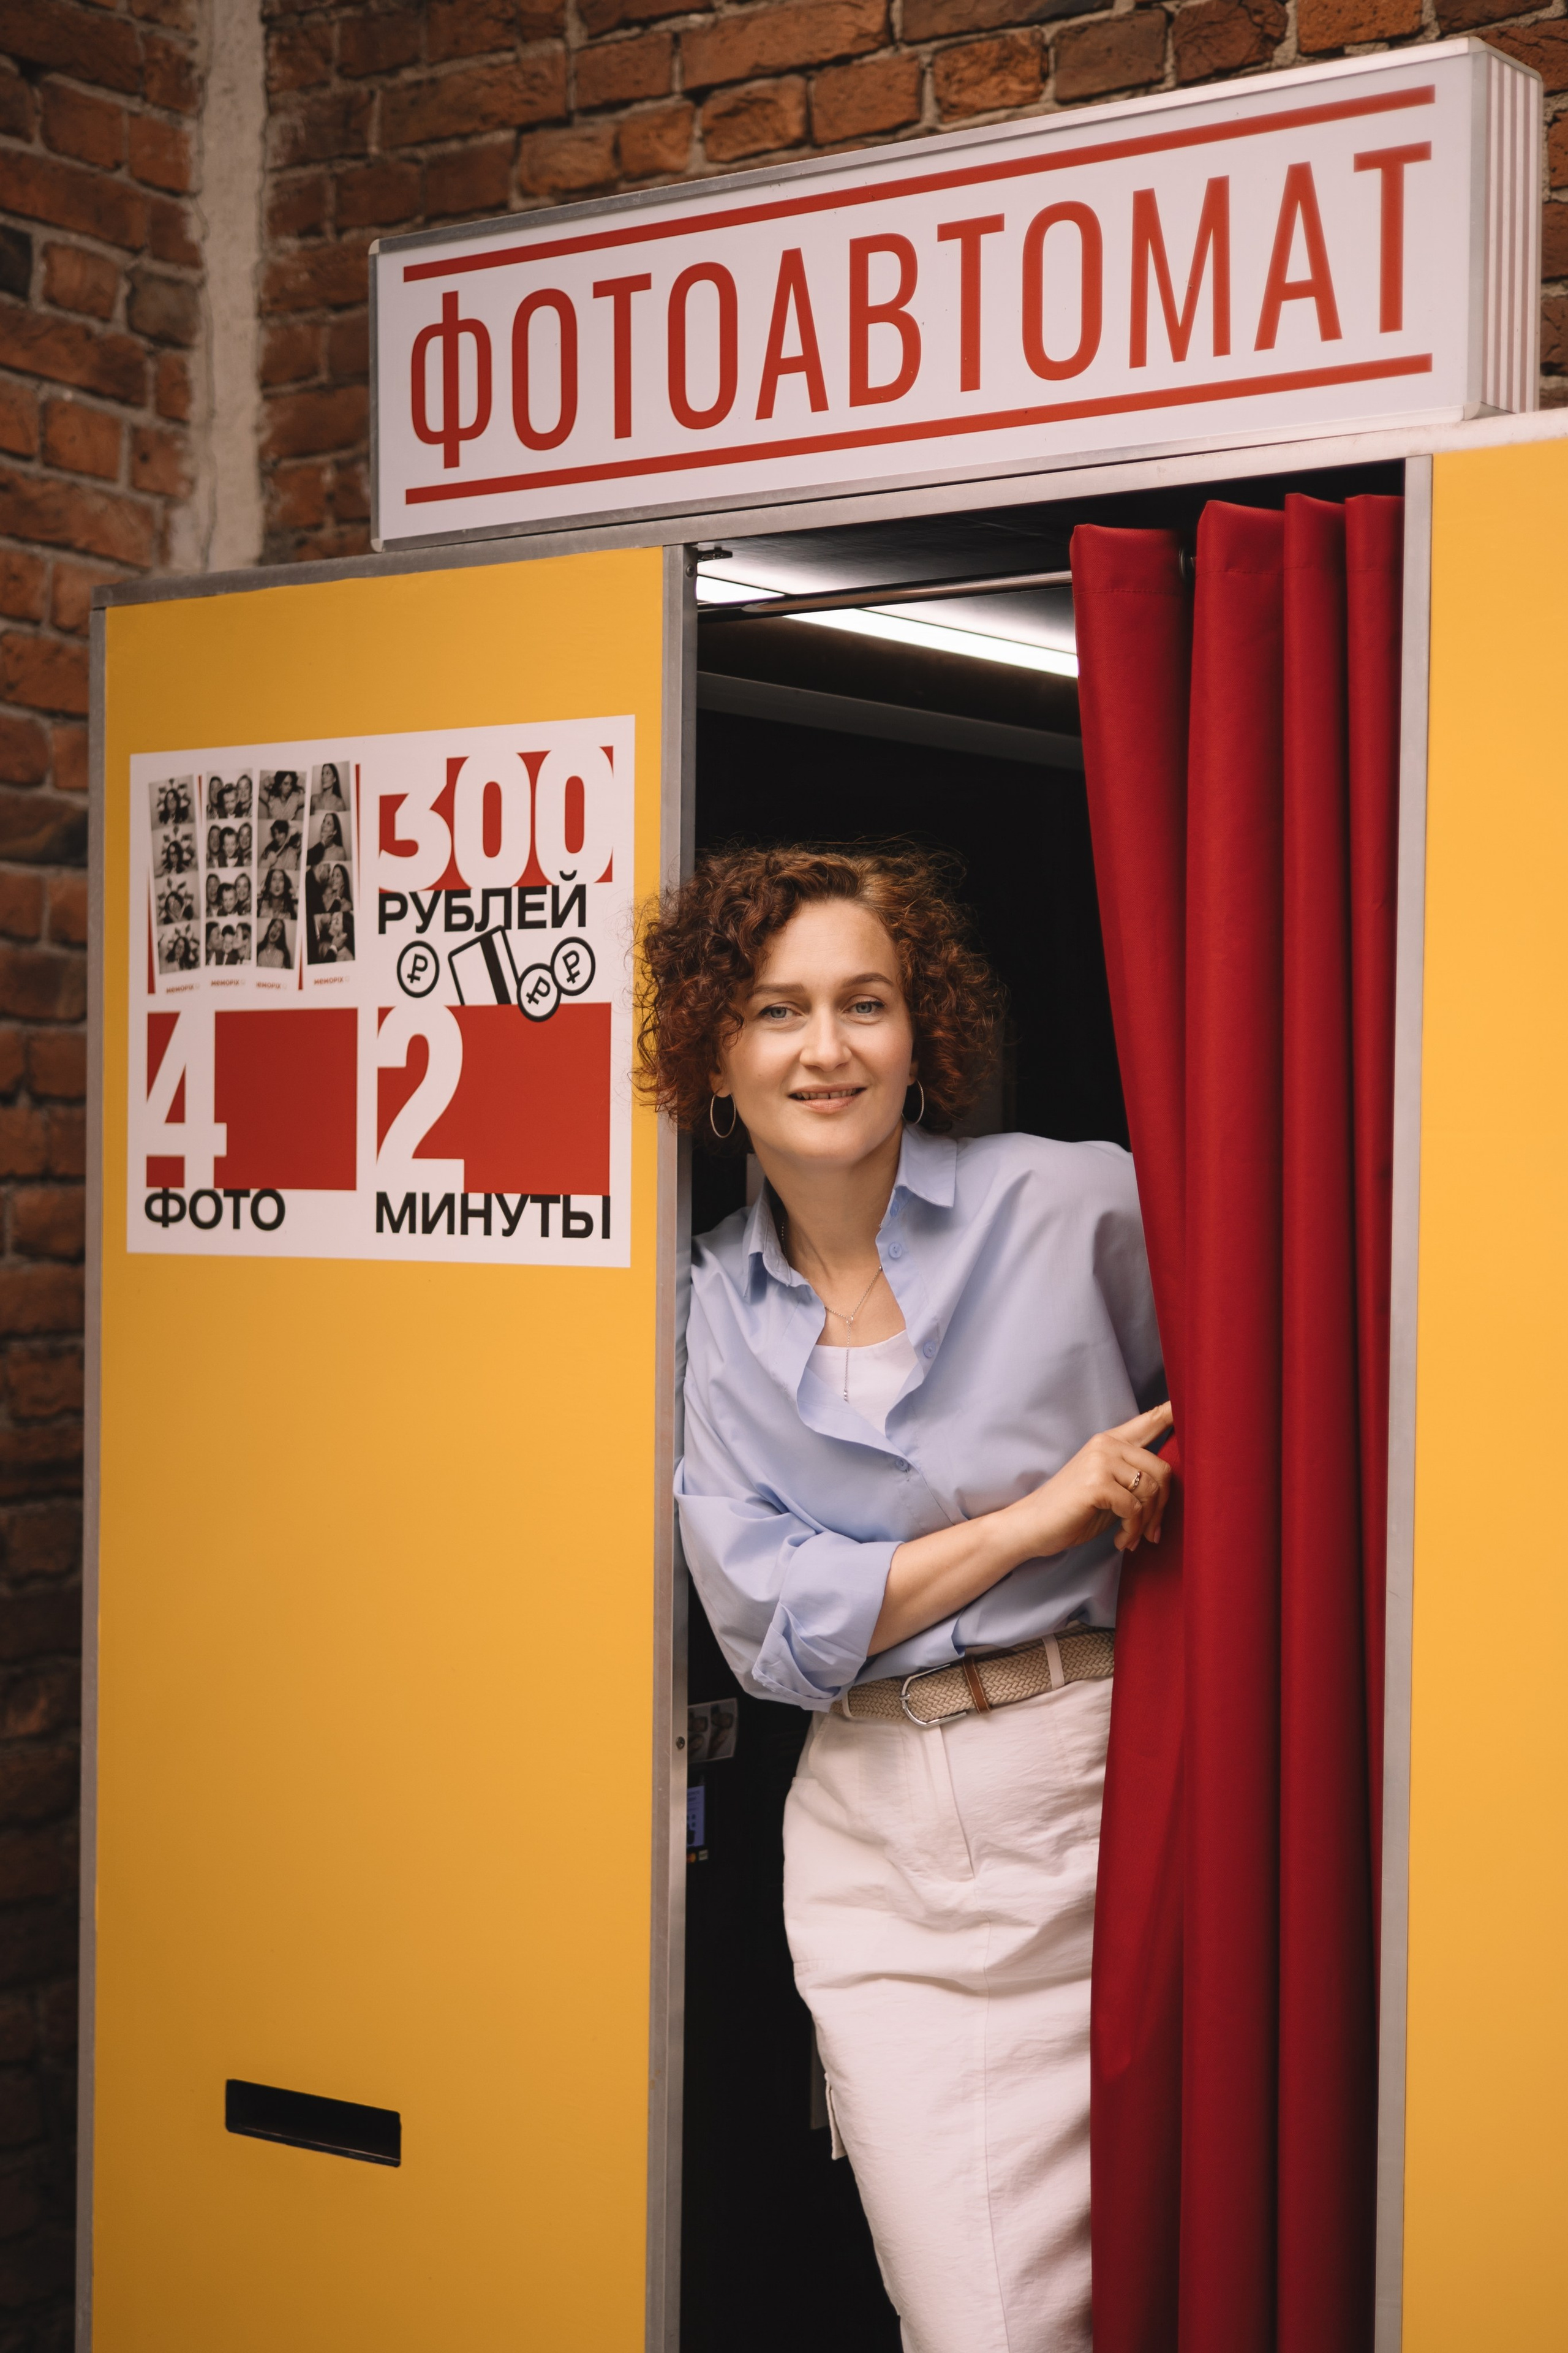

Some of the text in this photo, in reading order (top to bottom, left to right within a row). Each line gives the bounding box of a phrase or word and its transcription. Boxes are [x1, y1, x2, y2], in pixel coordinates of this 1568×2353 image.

[410, 141, 1431, 469] ФОТОАВТОМАТ
[378, 746, 614, 893] 300
[378, 870, 587, 935] РУБЛЕЙ
[147, 1011, 227, 1188] 4
[376, 1003, 464, 1193] 2
[145, 1187, 285, 1231] ФОТО
[376, 1192, 611, 1239] МИНУТЫ
